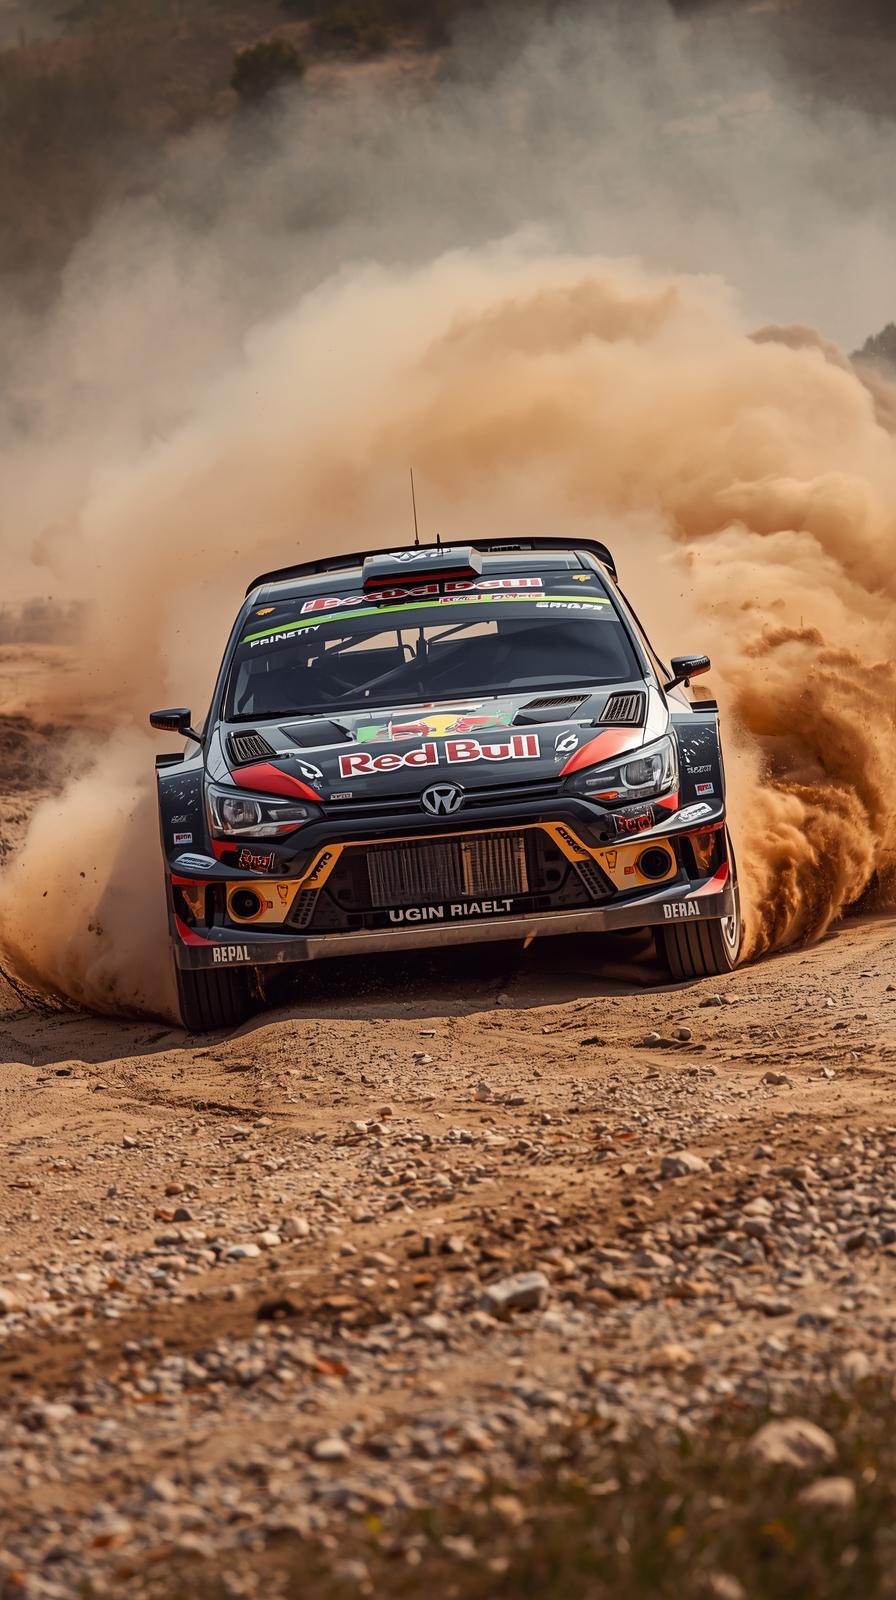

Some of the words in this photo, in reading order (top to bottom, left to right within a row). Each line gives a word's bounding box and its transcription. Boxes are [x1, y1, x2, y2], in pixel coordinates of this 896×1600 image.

[338, 742, 439, 778] Red
[445, 734, 540, 764] Bull
[389, 906, 444, 922] UGIN
[450, 900, 514, 916] RIAELT
